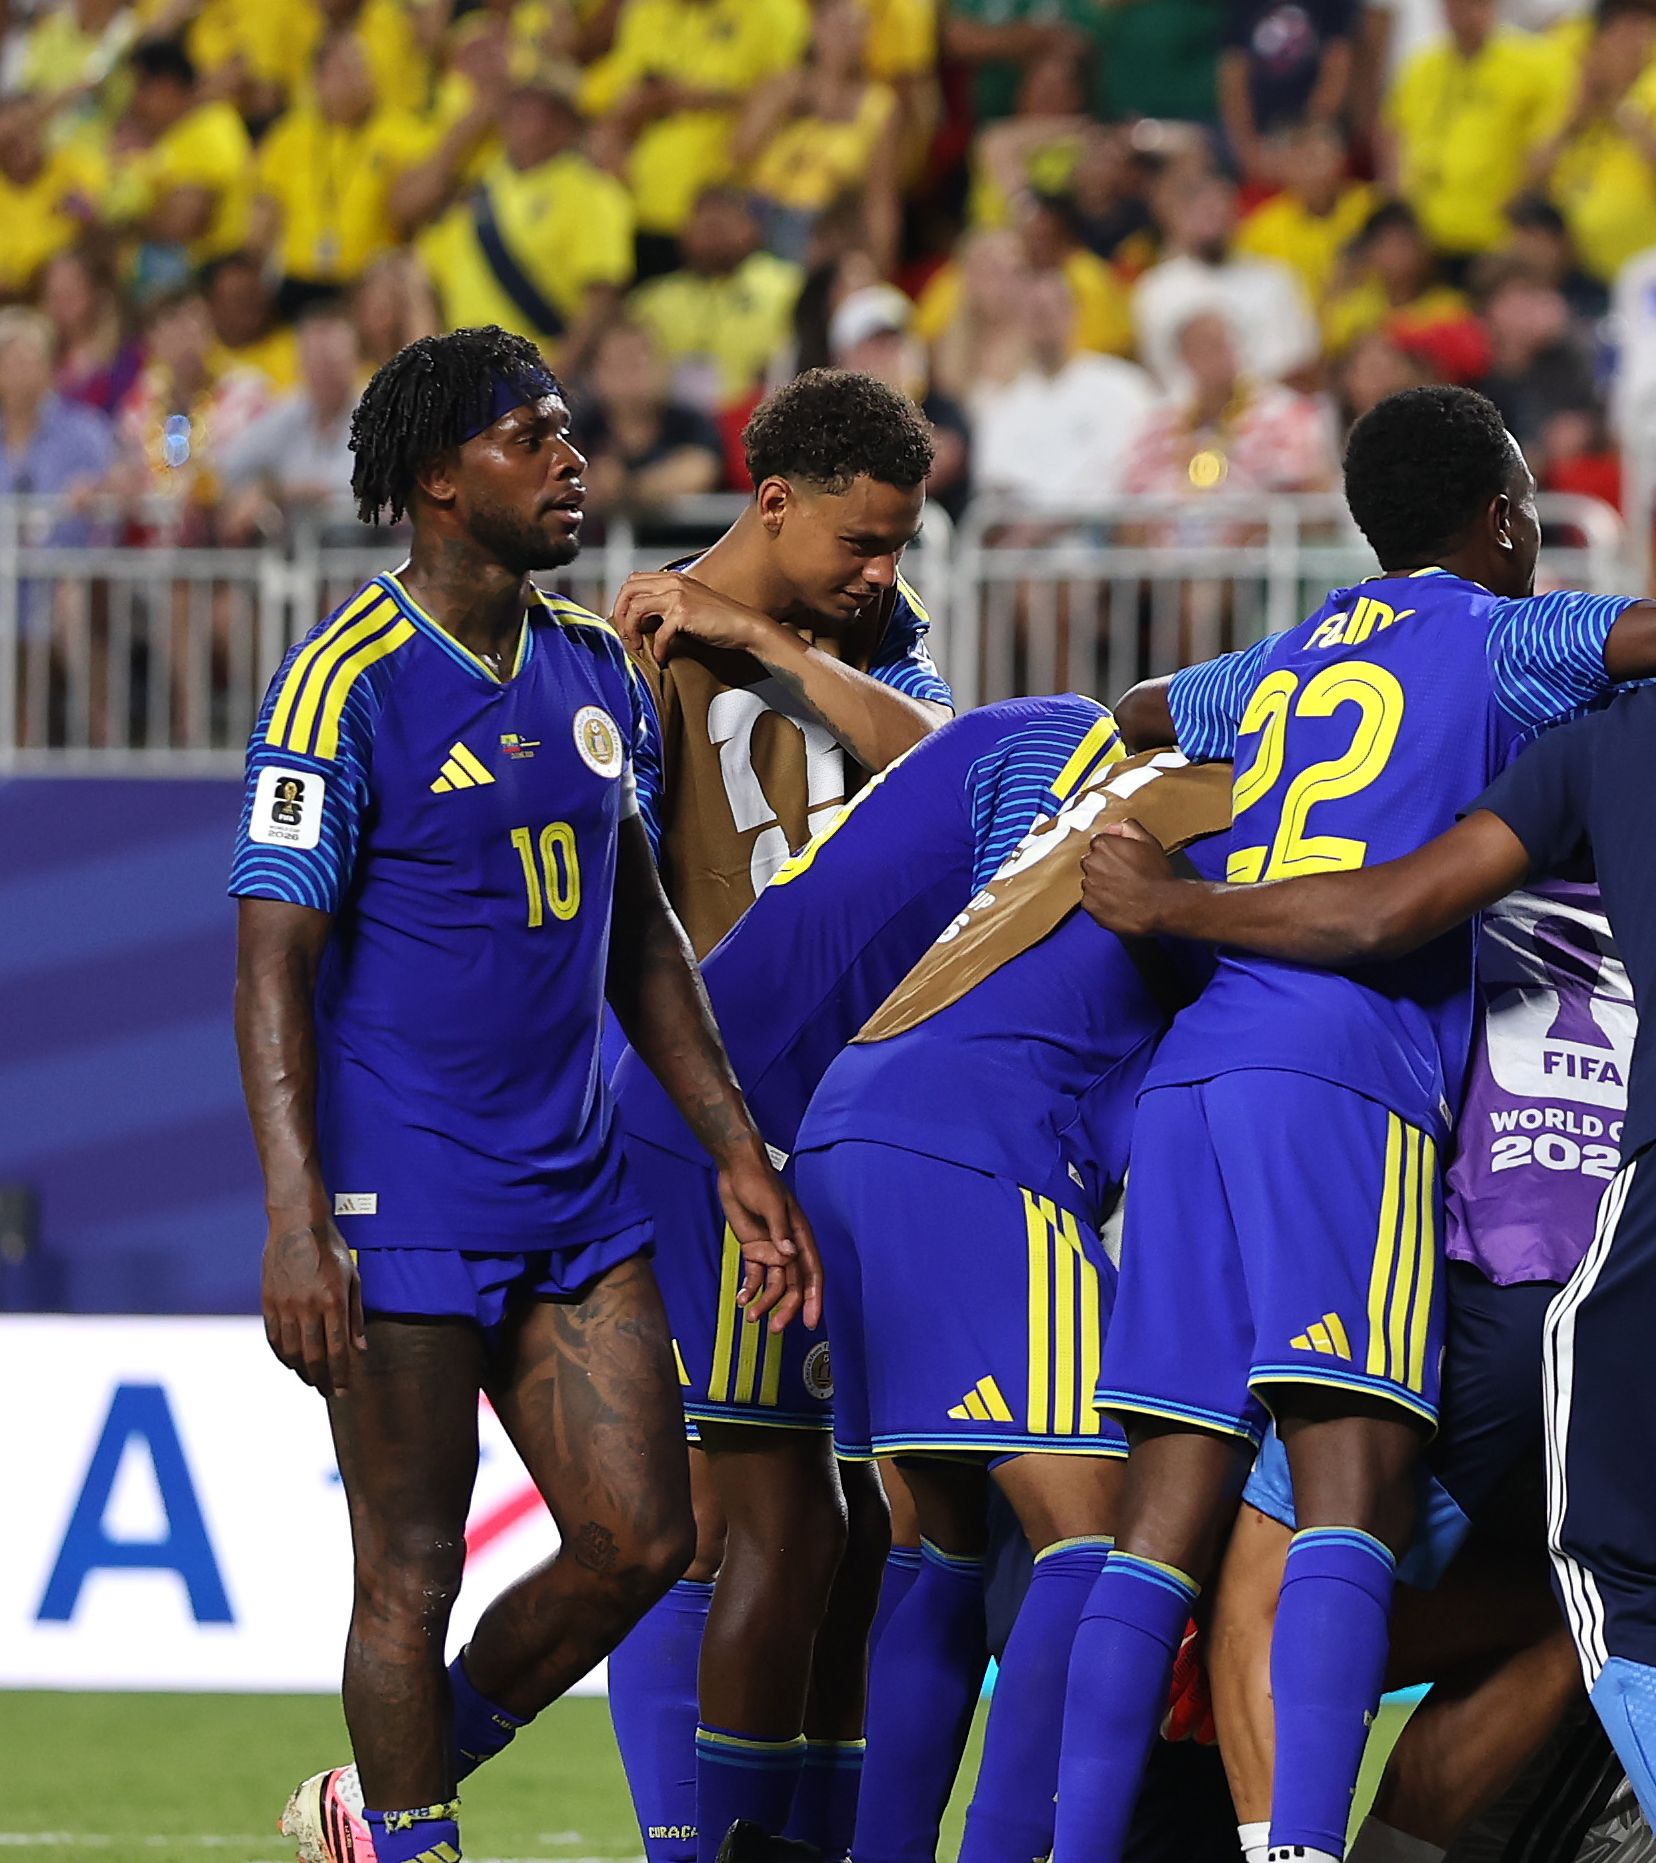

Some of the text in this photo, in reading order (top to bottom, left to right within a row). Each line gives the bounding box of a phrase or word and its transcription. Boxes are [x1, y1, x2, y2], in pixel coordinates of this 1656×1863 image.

[1226, 660, 1405, 883] 22
[510, 821, 581, 928] 10
[1543, 1050, 1624, 1087] FIFA
[1489, 1107, 1604, 1138] WORLD
